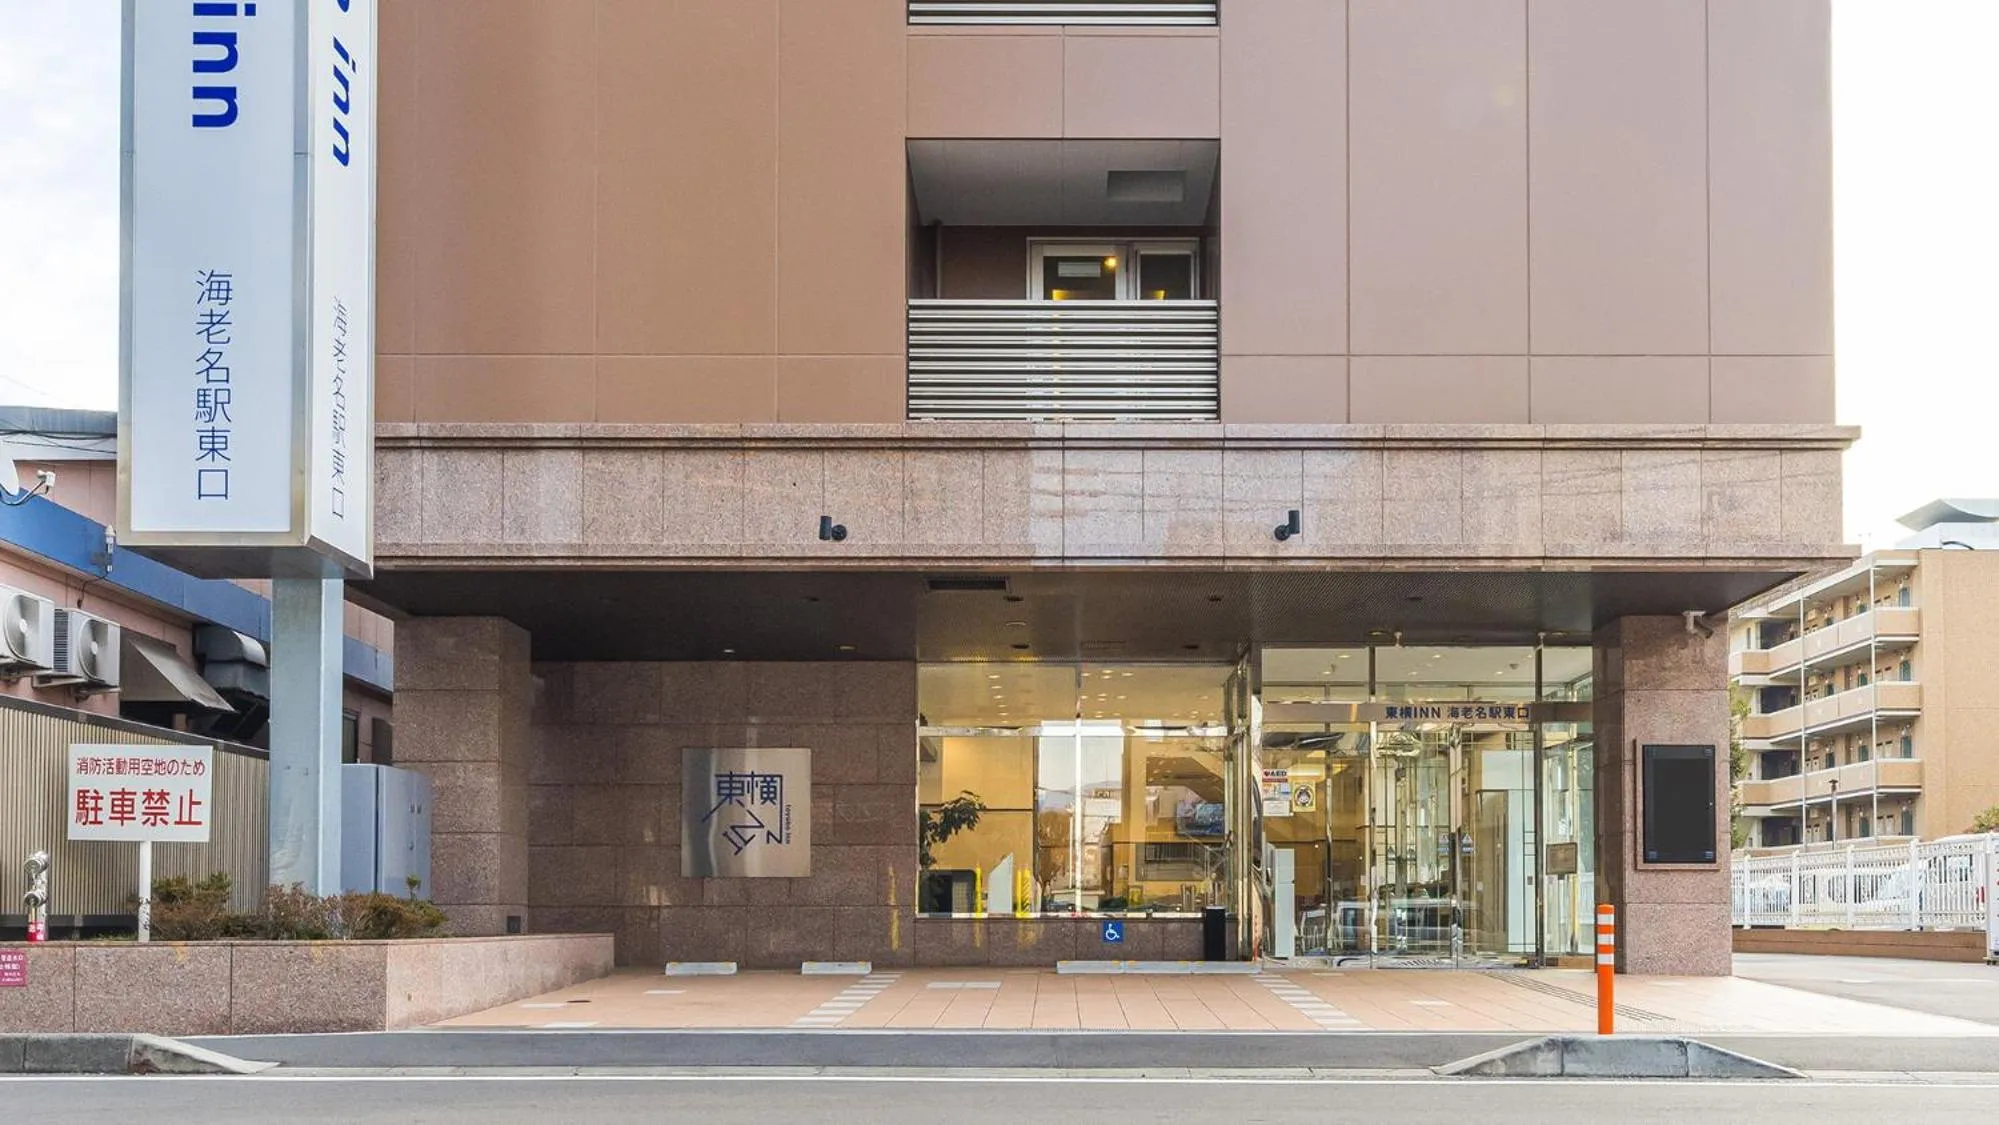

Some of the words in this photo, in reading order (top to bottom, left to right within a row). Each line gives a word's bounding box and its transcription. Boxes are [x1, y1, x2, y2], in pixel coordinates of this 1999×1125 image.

[192, 3, 256, 127] inn
[333, 36, 356, 167] inn
[195, 269, 233, 500] 海老名駅東口
[1386, 706, 1441, 719] 東横INN
[1447, 706, 1530, 719] 海老名駅東口
[76, 757, 206, 776] 消防活動用空地のため
[76, 788, 203, 826] 駐車禁止
